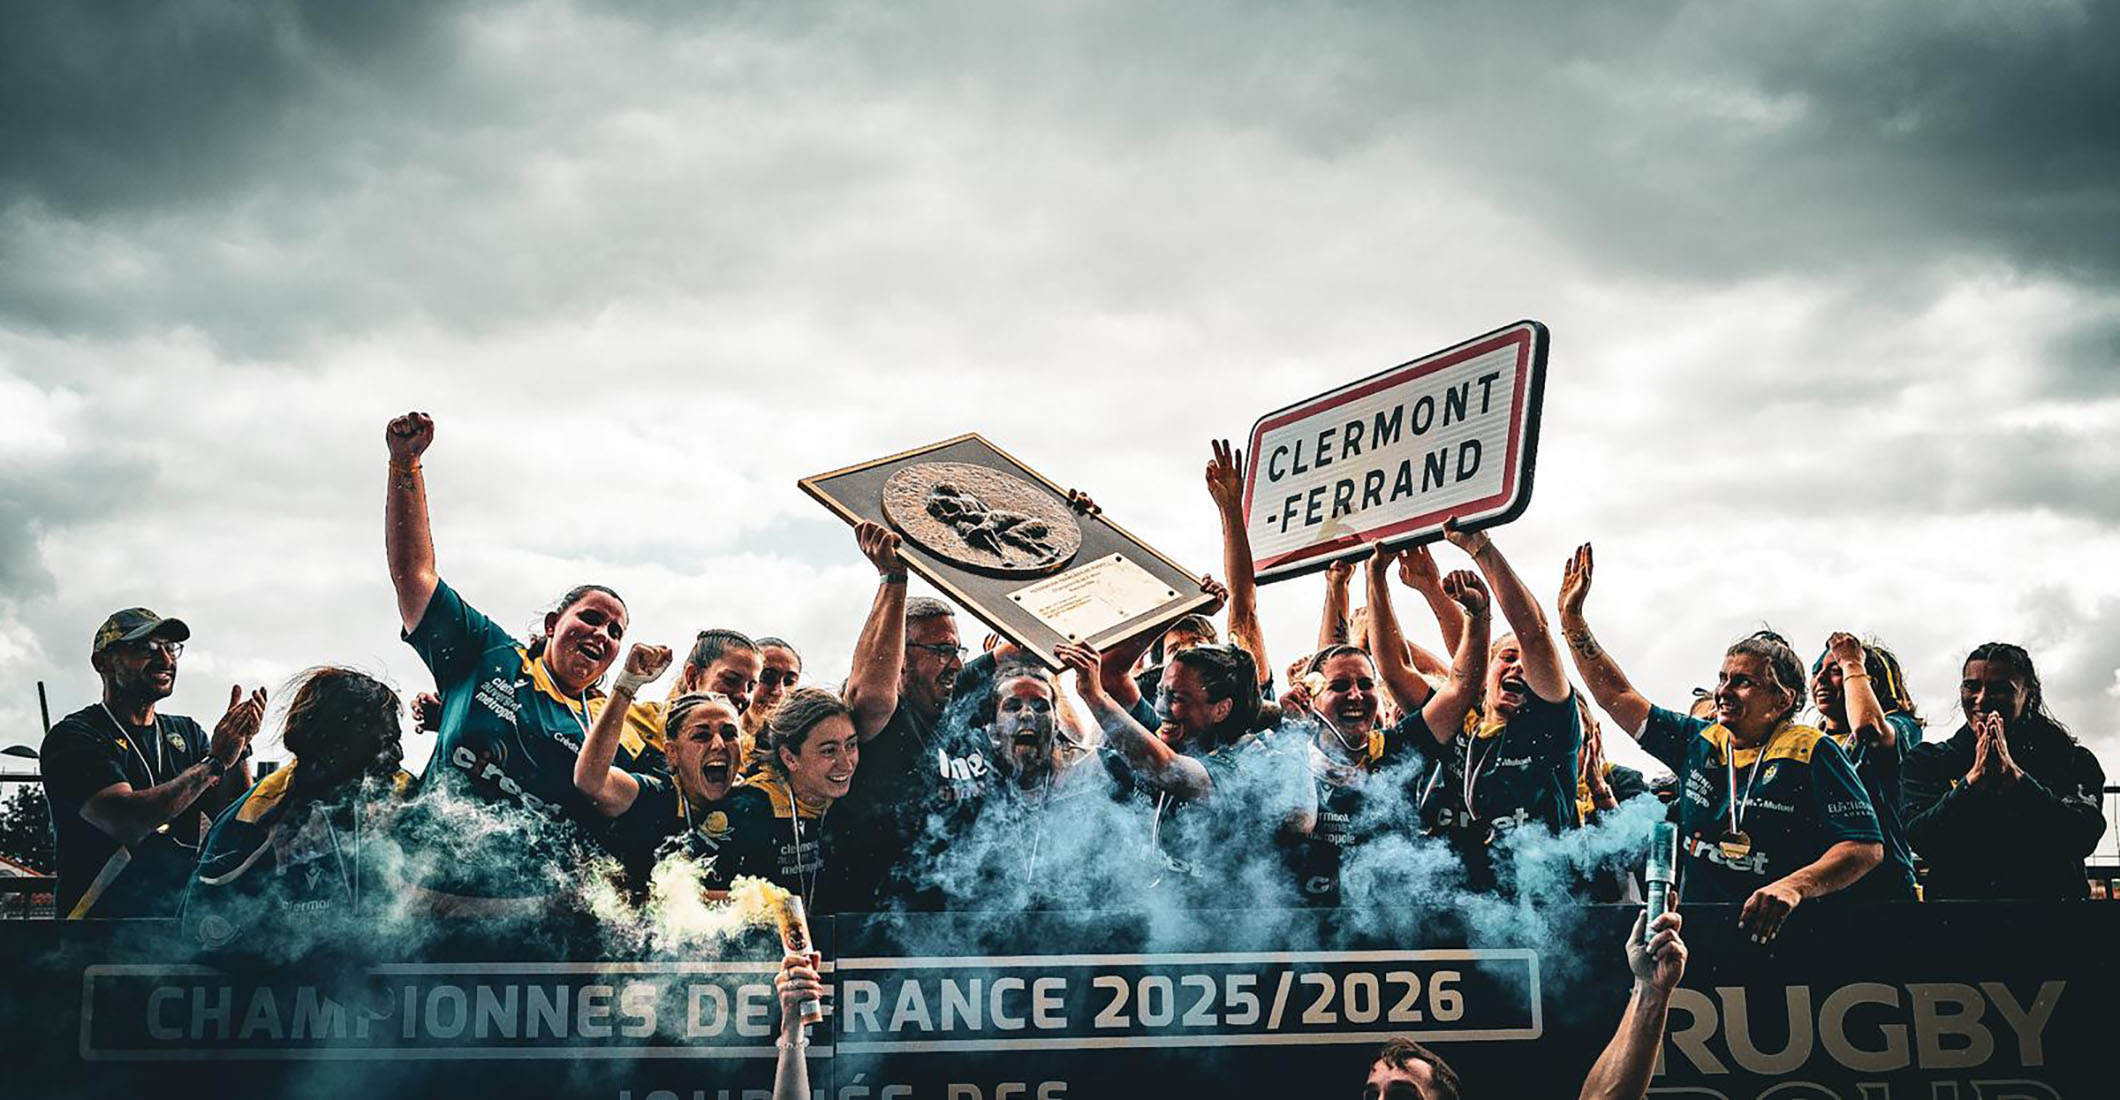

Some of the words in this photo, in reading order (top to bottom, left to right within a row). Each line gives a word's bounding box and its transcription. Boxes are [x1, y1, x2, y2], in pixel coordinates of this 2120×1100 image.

[1267, 371, 1500, 483] CLERMONT
[1266, 438, 1483, 534] -FERRAND
[686, 983, 772, 1038] DE
[1092, 969, 1465, 1030] 2025/2026
[1631, 980, 2067, 1076] RUGBY
